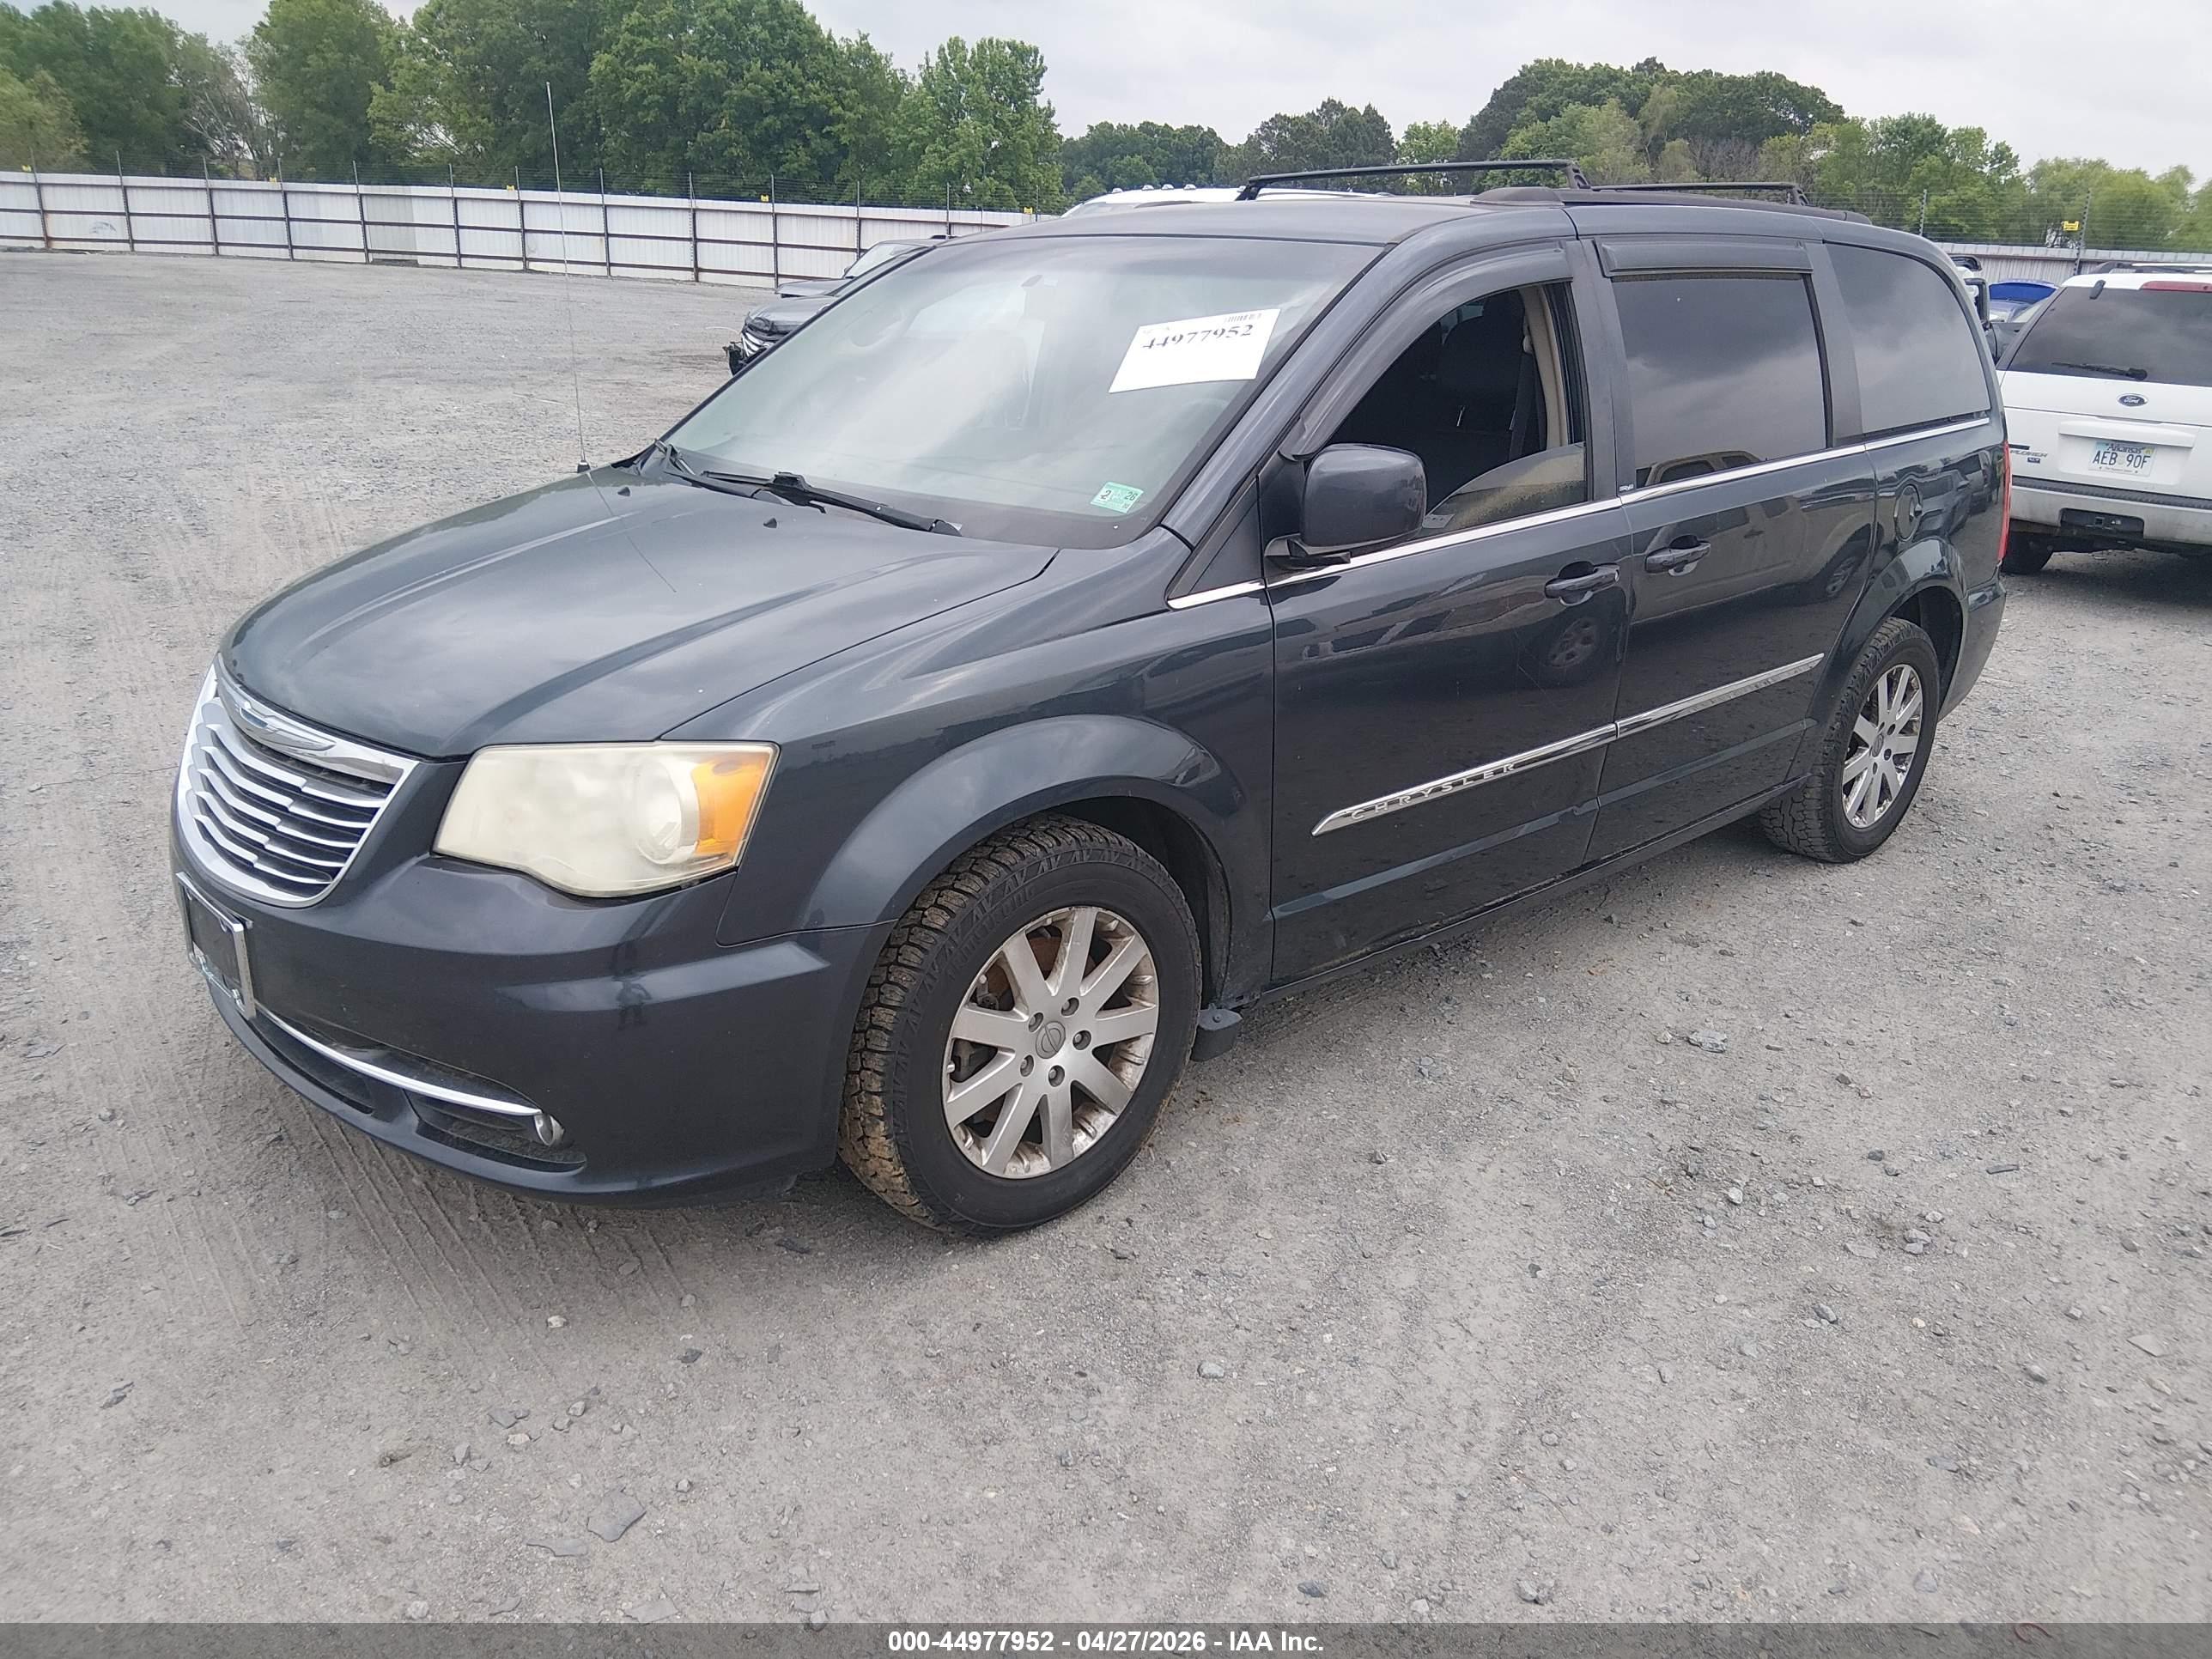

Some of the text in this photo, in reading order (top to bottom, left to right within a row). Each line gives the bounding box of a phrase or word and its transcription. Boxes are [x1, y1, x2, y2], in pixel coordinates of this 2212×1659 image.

[1142, 324, 1254, 349] 44977952
[2106, 443, 2142, 454] Arkansas
[2092, 450, 2118, 465] AEB
[1100, 489, 1112, 500] 2
[1351, 763, 1516, 821] CHRYSLER
